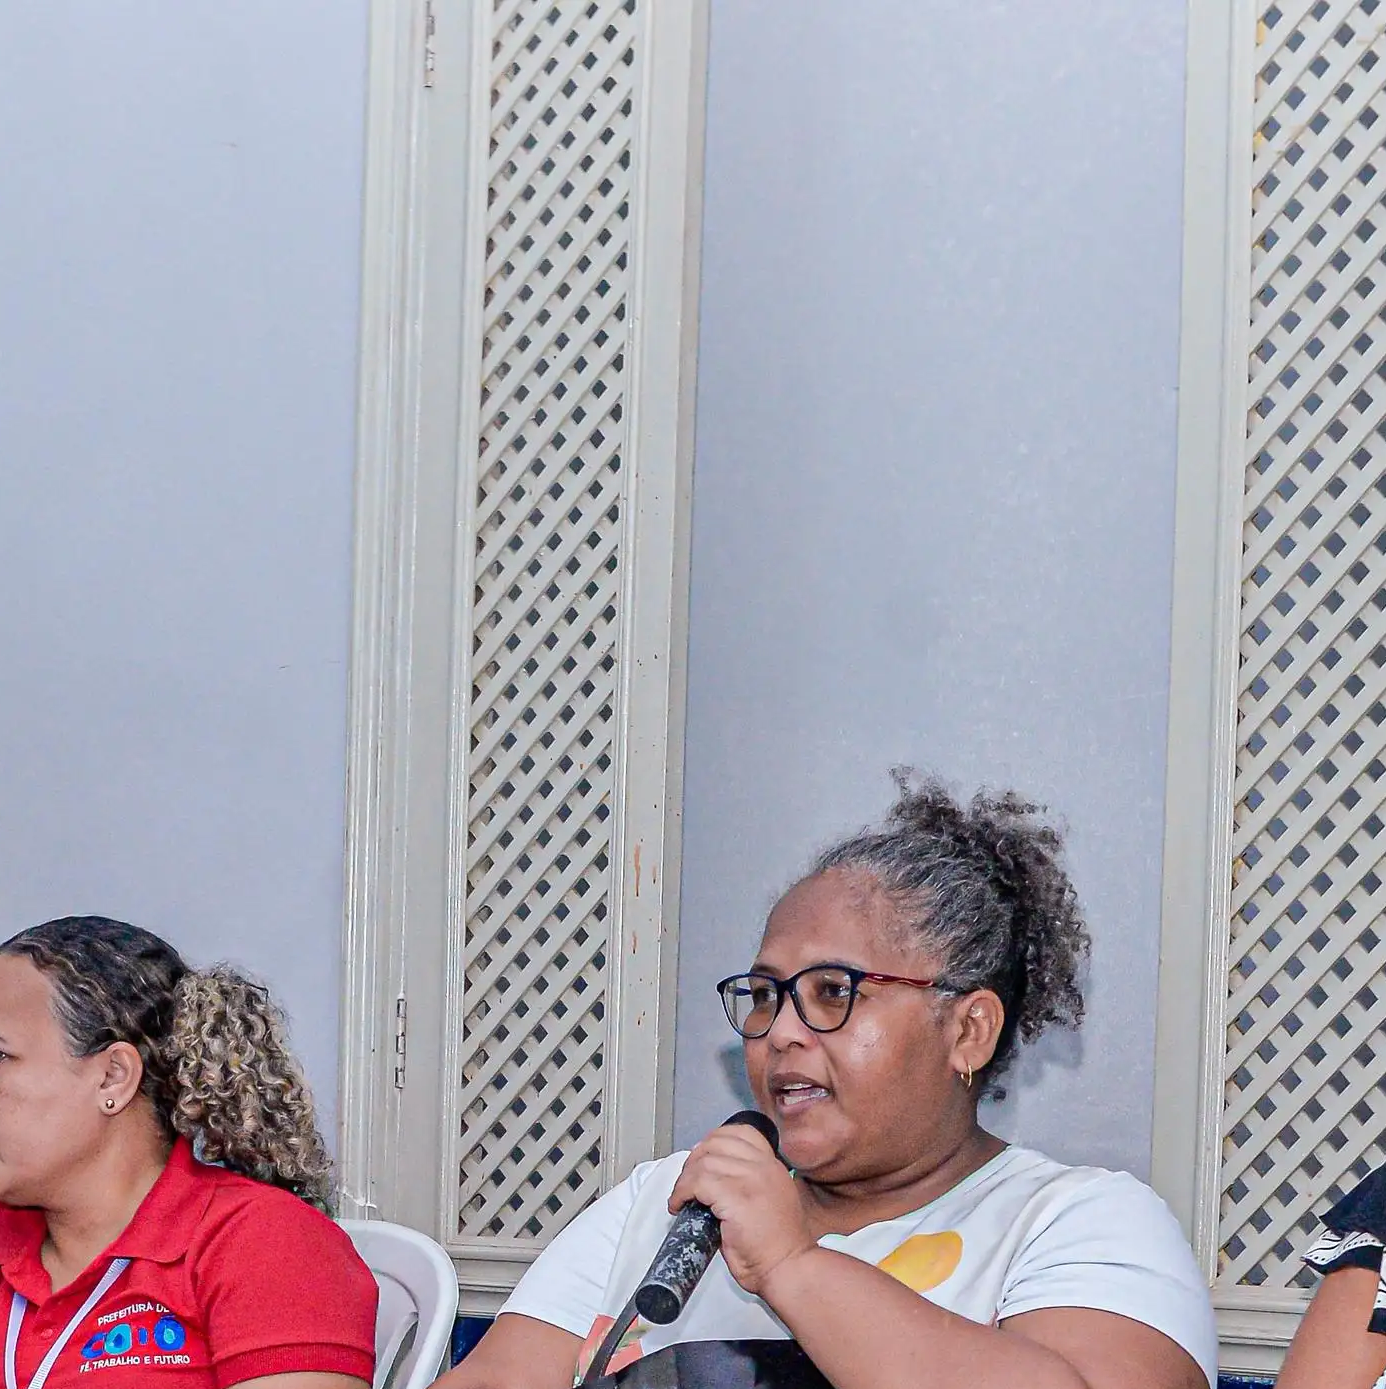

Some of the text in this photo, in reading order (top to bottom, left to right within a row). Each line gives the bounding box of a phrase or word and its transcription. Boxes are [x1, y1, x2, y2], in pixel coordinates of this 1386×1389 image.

[97, 1302, 154, 1326] PREFEITURA
[92, 1355, 140, 1371] TRABALHO
[144, 1356, 151, 1364] E
[154, 1354, 191, 1365] FUTURO
